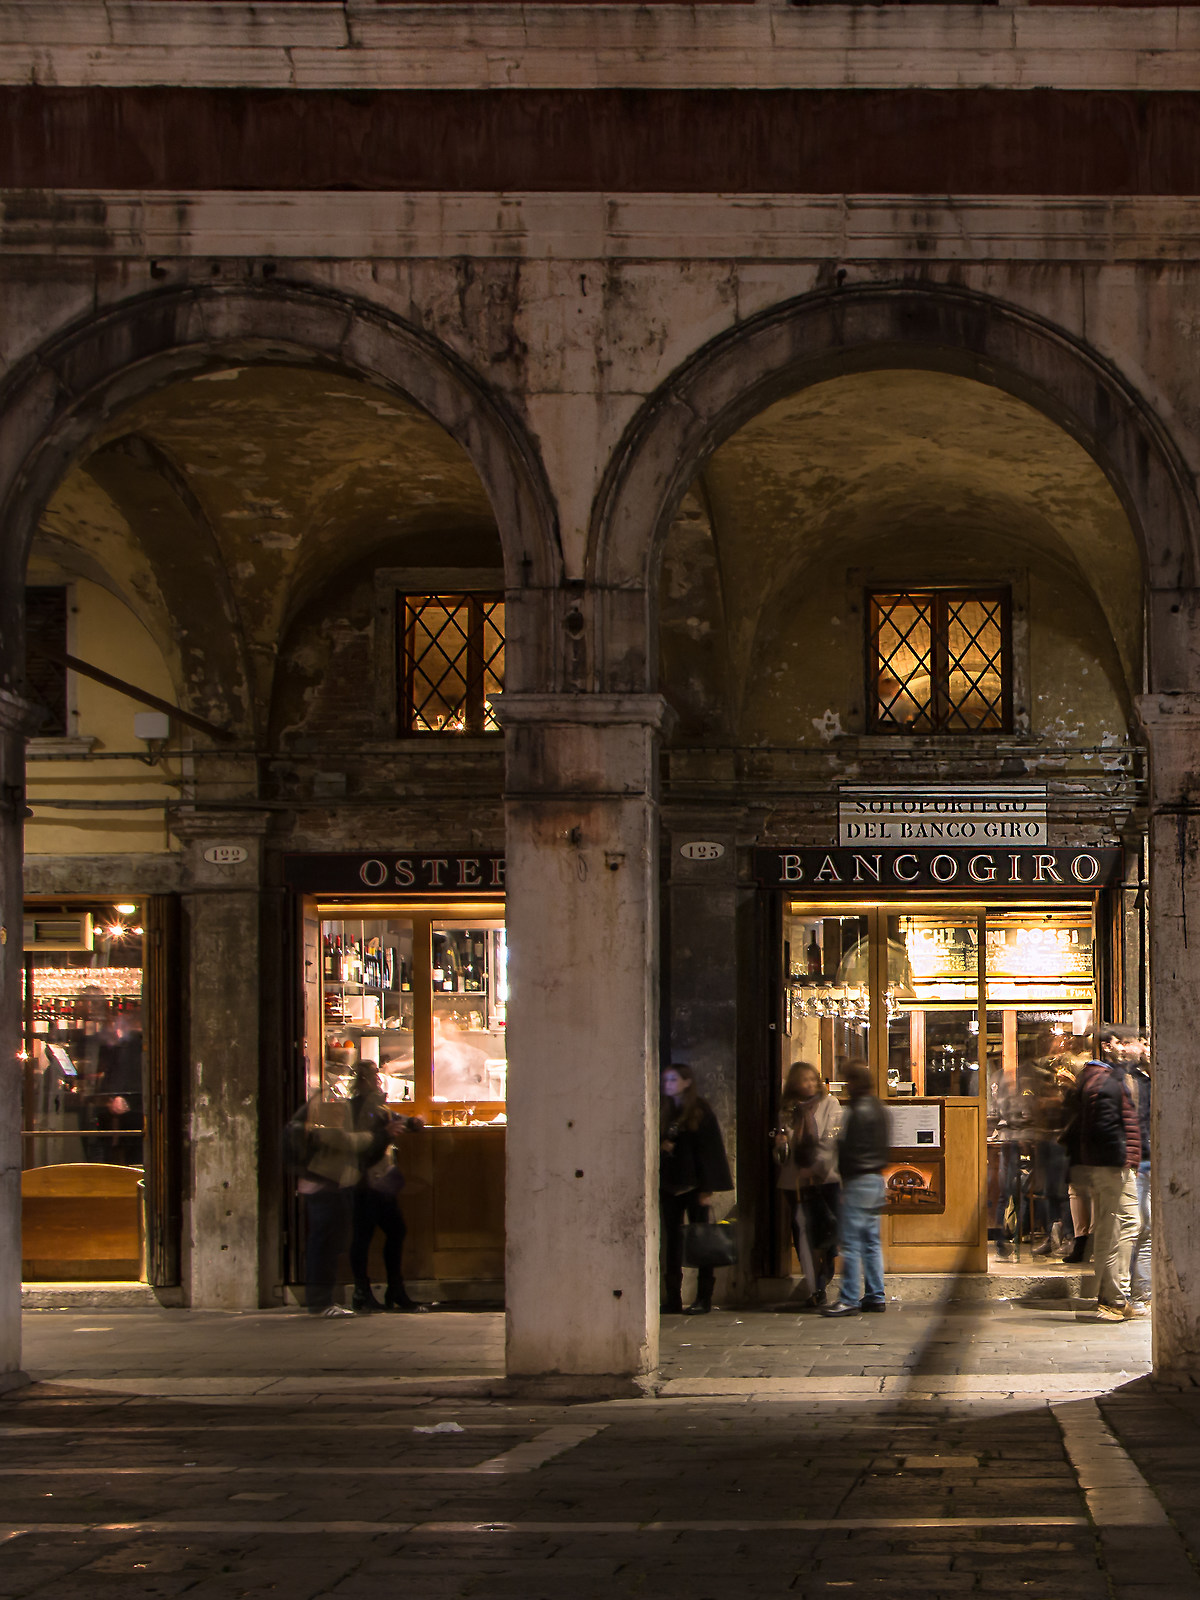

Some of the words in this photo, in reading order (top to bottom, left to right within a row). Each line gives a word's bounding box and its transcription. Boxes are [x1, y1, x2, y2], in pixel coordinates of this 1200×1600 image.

[847, 823, 891, 838] DEL
[901, 822, 976, 838] BANCO
[984, 822, 1040, 838] GIRO
[214, 849, 240, 860] 122
[778, 854, 1100, 883] BANCOGIRO
[967, 928, 1006, 946] VNI
[1016, 928, 1080, 944] ROSSI
